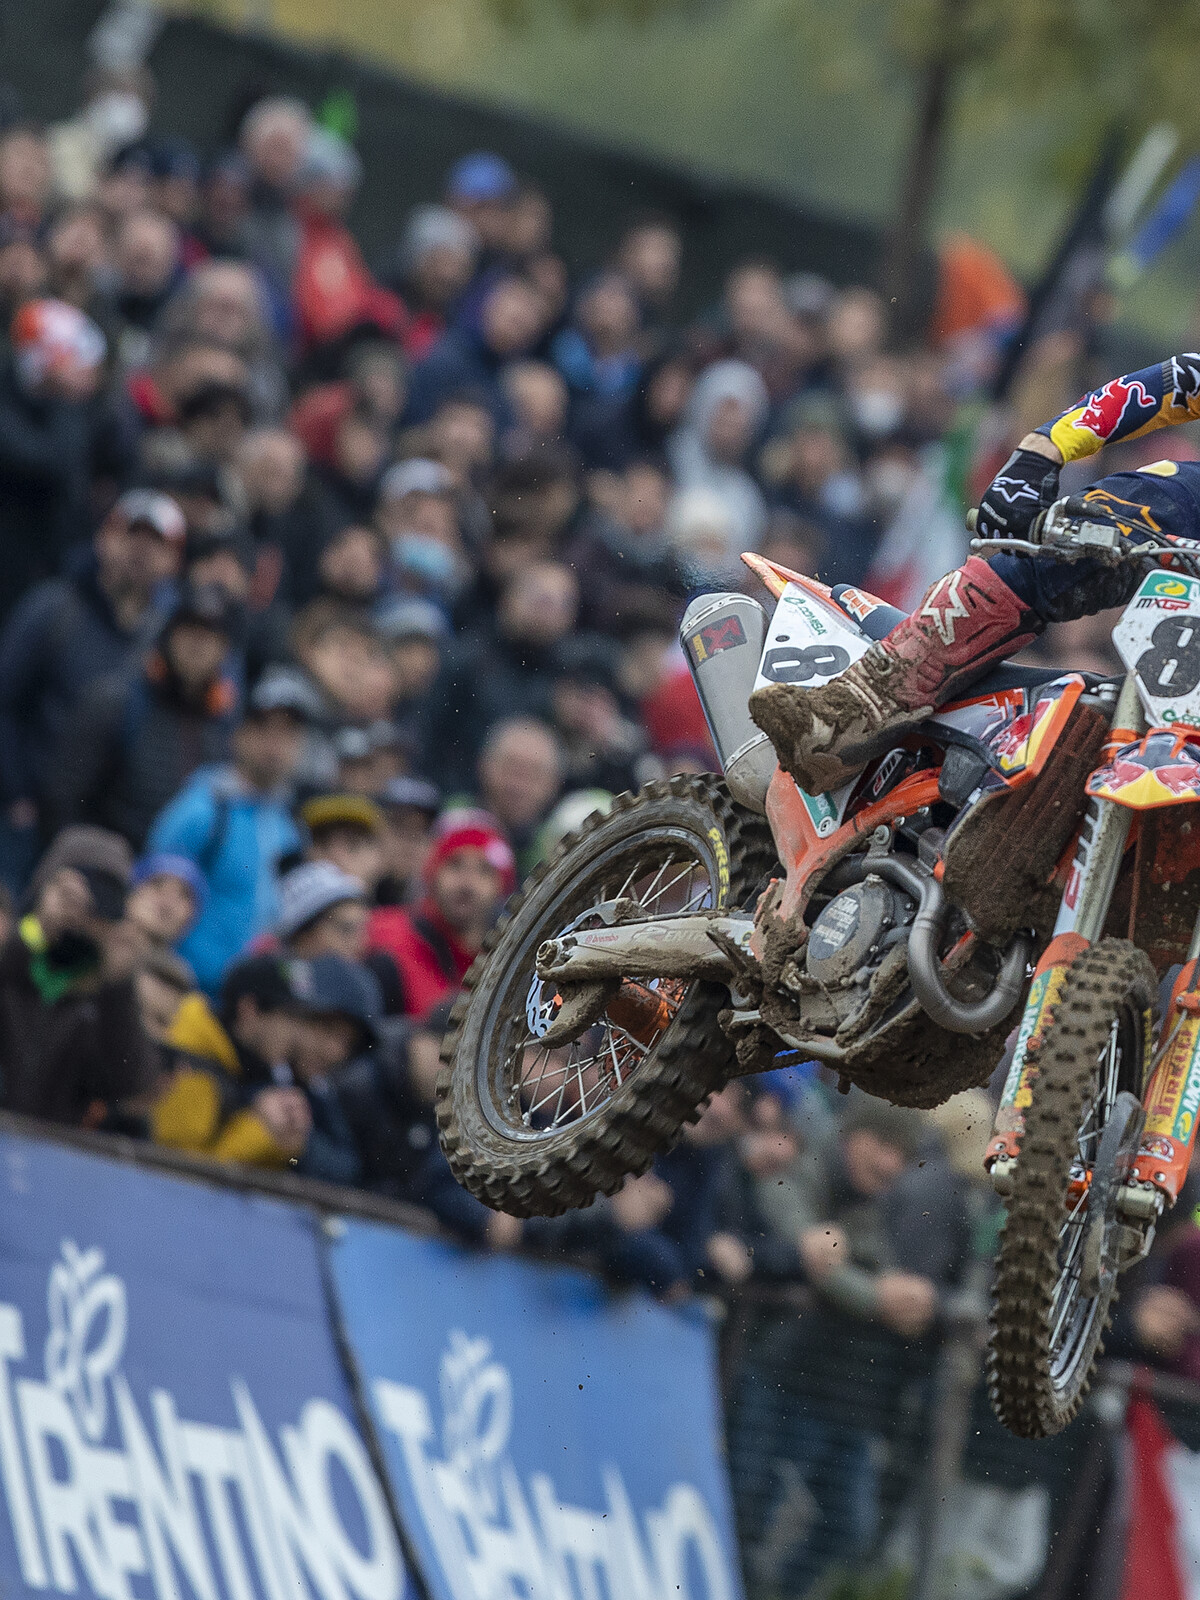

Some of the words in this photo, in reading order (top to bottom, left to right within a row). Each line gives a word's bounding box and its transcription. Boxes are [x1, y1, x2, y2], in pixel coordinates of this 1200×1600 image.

[707, 826, 730, 911] PIREL
[1001, 1006, 1040, 1106] MOTOREX
[1151, 1029, 1194, 1117] PIRELLI
